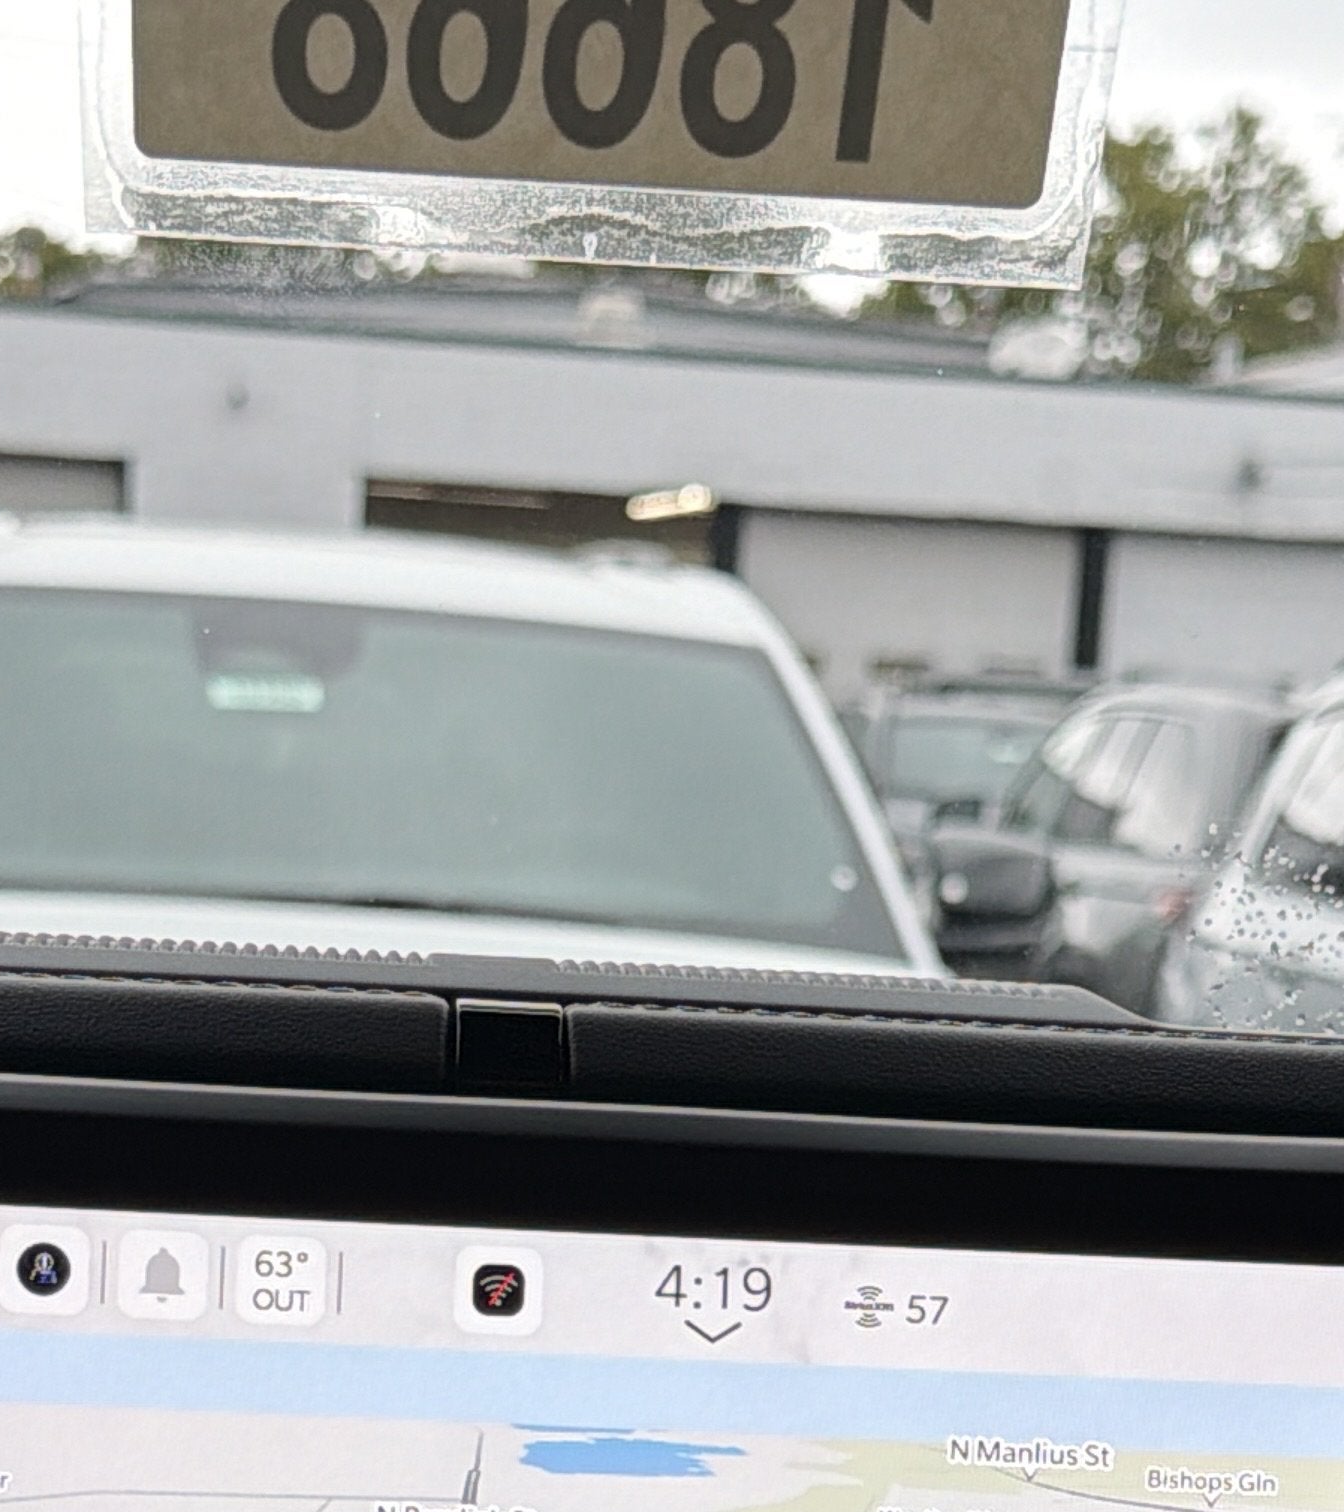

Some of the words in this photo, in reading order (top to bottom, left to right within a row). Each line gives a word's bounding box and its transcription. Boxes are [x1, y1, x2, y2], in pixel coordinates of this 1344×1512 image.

[254, 1250, 309, 1278] 63°
[252, 1288, 310, 1313] OUT
[655, 1264, 772, 1312] 4:19
[905, 1295, 950, 1325] 57
[950, 1441, 968, 1460] N
[976, 1441, 1080, 1466] Manlius
[1085, 1447, 1110, 1467] St
[1147, 1470, 1233, 1494] Bishops
